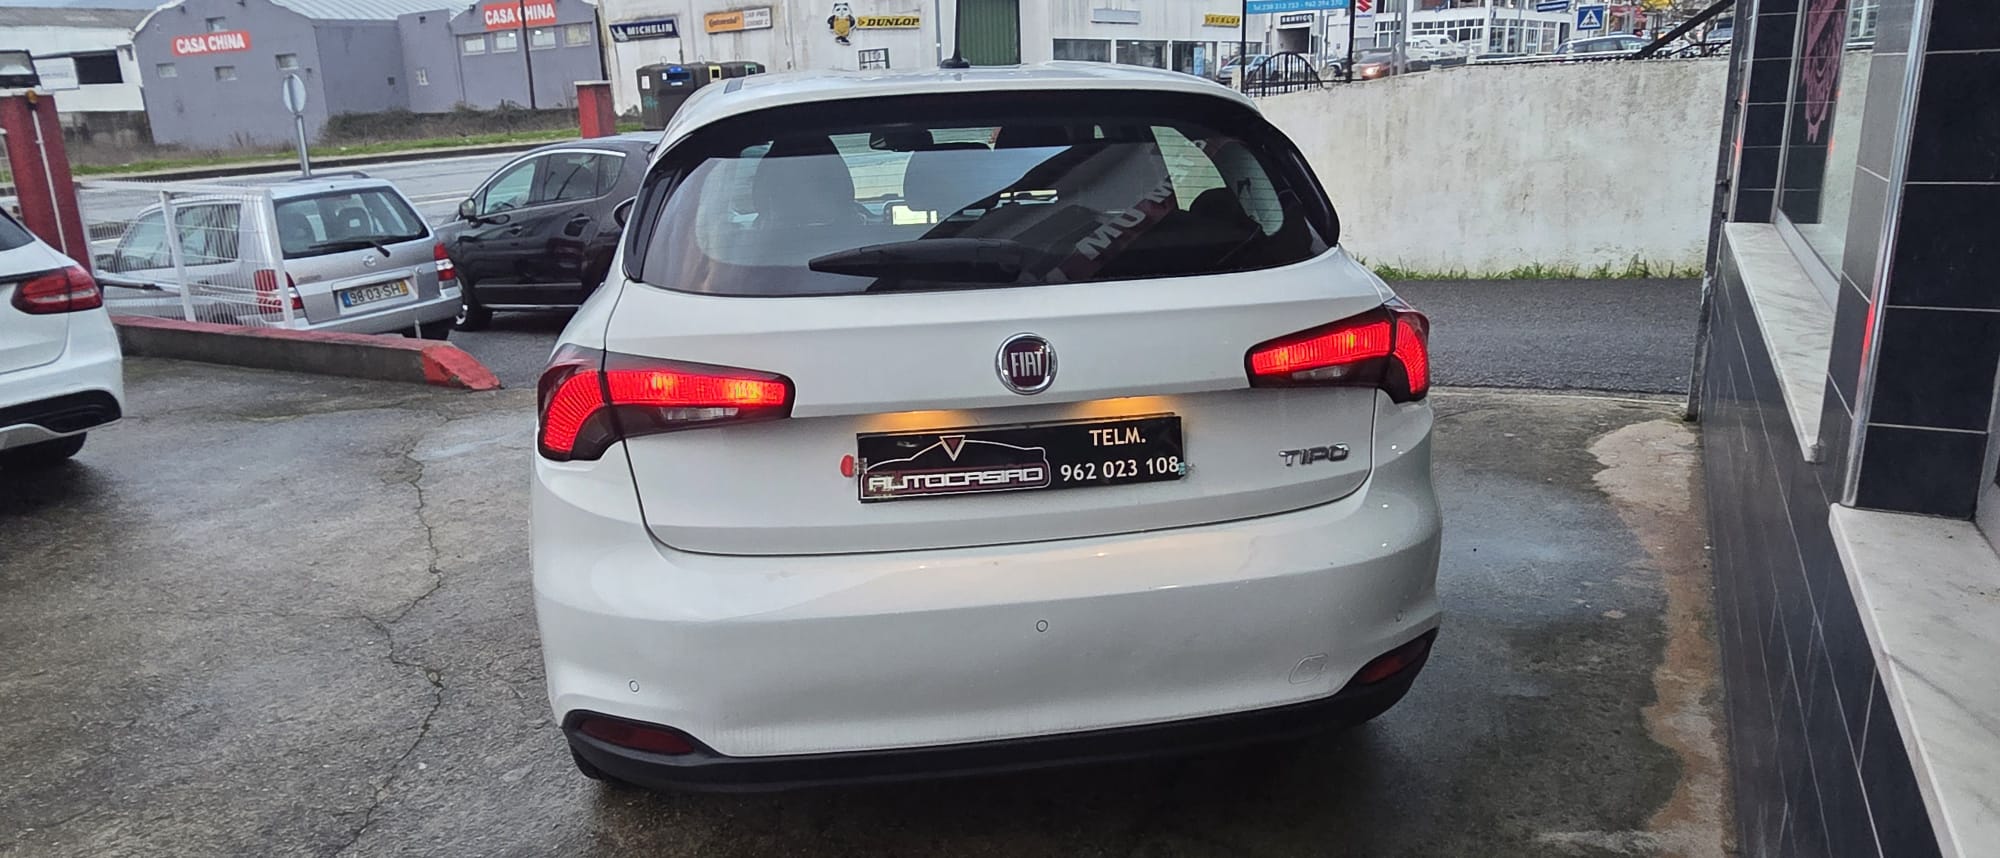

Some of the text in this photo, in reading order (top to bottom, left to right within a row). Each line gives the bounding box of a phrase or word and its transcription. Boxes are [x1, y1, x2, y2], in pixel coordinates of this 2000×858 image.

[485, 3, 555, 25] CASA CHINA
[867, 18, 920, 26] DUNLOP
[627, 23, 673, 35] MICHELIN
[176, 33, 246, 54] CASA CHINA
[1010, 351, 1043, 378] FIAT
[1089, 427, 1147, 446] TELM.
[1279, 443, 1350, 467] TIPO
[1060, 456, 1178, 482] 962 023 108
